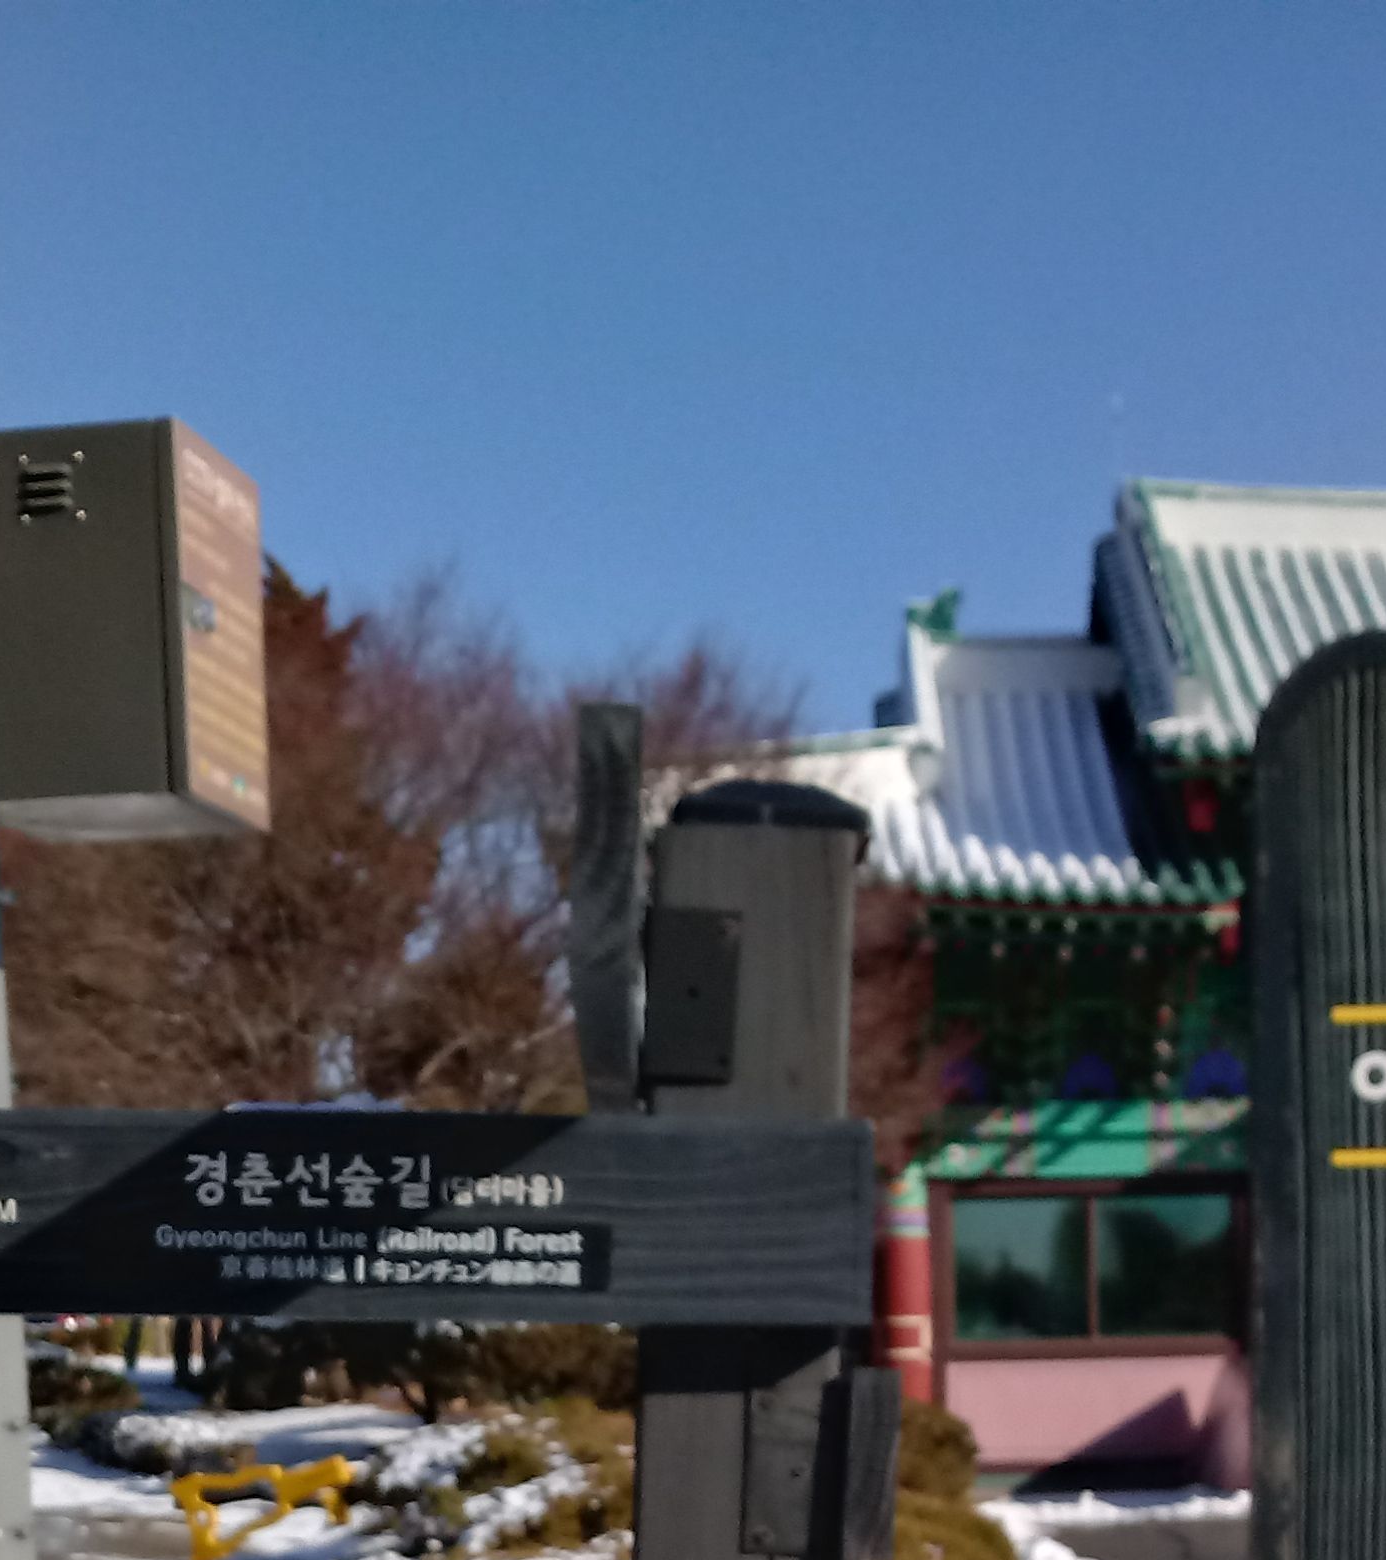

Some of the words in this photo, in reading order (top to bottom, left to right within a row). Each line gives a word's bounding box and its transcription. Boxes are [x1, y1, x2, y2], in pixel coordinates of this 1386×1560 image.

[184, 1151, 431, 1209] 경춘선숲길
[155, 1224, 307, 1251] Gyeongchun
[318, 1226, 368, 1250] Line
[503, 1226, 584, 1255] Forest
